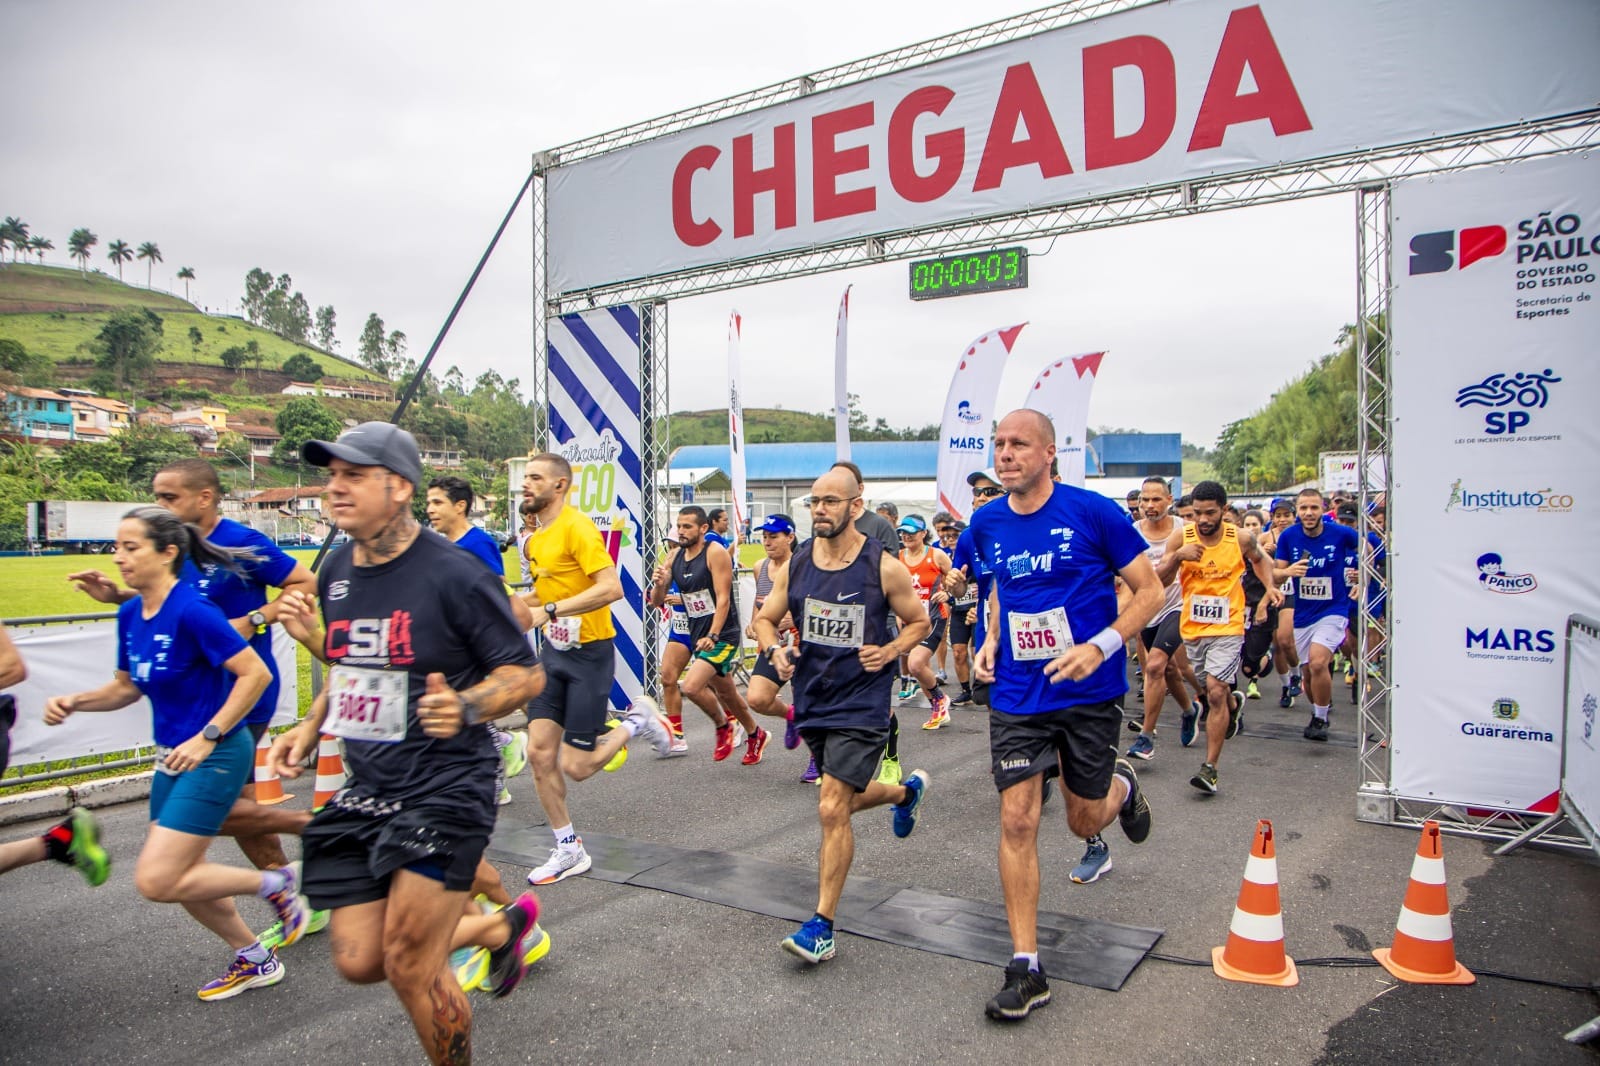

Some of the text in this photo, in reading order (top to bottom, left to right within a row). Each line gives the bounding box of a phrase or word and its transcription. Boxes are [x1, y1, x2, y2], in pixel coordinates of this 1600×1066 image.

[671, 4, 1314, 247] CHEGADA
[1517, 211, 1581, 240] SÃO
[914, 251, 1019, 291] 00:00:03
[1516, 263, 1588, 279] GOVERNO
[1517, 273, 1596, 290] DO ESTADO
[1516, 292, 1591, 308] Secretaria de
[1516, 307, 1570, 320] Esportes
[1484, 411, 1530, 434] SP
[949, 436, 984, 449] MARS
[1462, 490, 1543, 507] Instituto
[1488, 577, 1533, 588] PANCO
[1194, 604, 1222, 618] 1121
[810, 617, 849, 638] 1122
[1017, 629, 1056, 649] 5376
[1466, 627, 1556, 653] MARS
[1466, 651, 1506, 660] Tomorrow
[1531, 656, 1555, 664] today
[1461, 722, 1554, 742] Guararema
